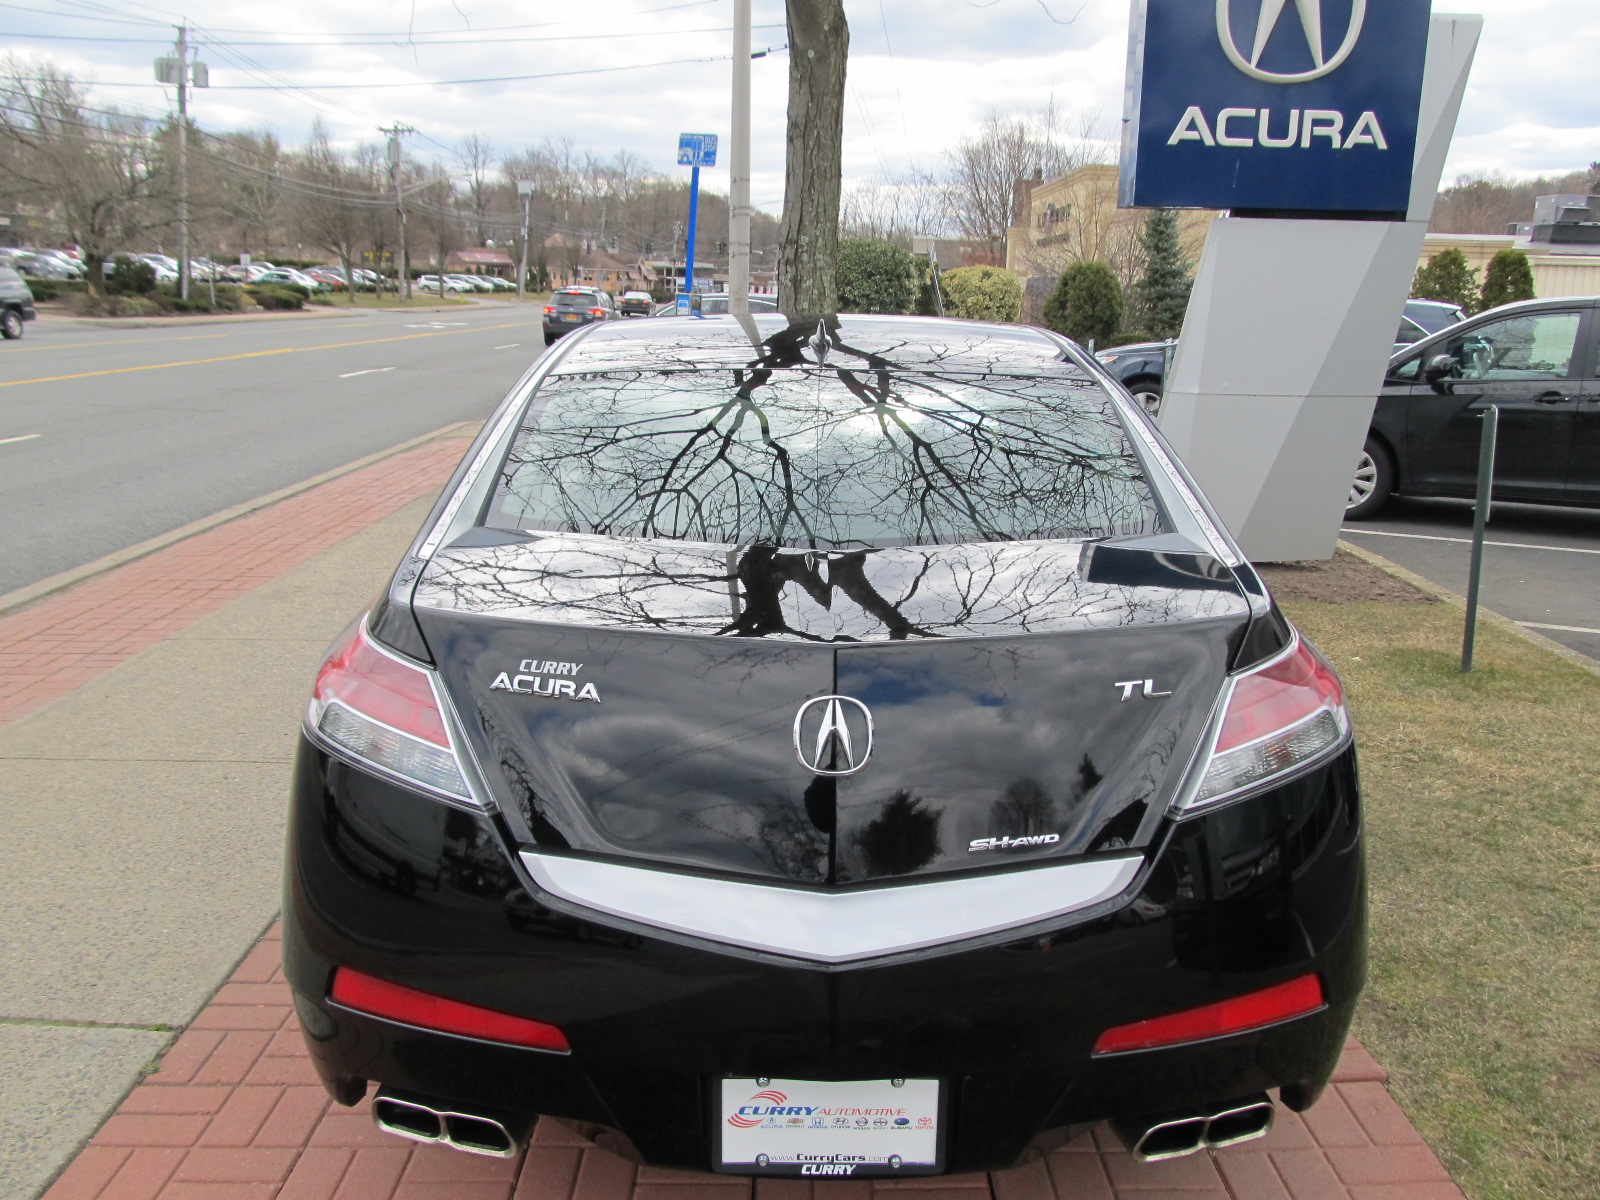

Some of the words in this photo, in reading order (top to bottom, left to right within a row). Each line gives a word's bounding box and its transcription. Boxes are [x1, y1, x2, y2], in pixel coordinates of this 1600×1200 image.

[1167, 106, 1388, 149] ACURA
[704, 135, 717, 144] BUS
[519, 659, 583, 676] CURRY
[489, 671, 601, 703] ACURA
[1114, 679, 1172, 701] TL
[968, 833, 1060, 852] SH-AWD
[738, 1106, 819, 1116] CURRY
[817, 1107, 908, 1116] AUTOMOTIVE
[801, 1164, 857, 1175] CURRY
